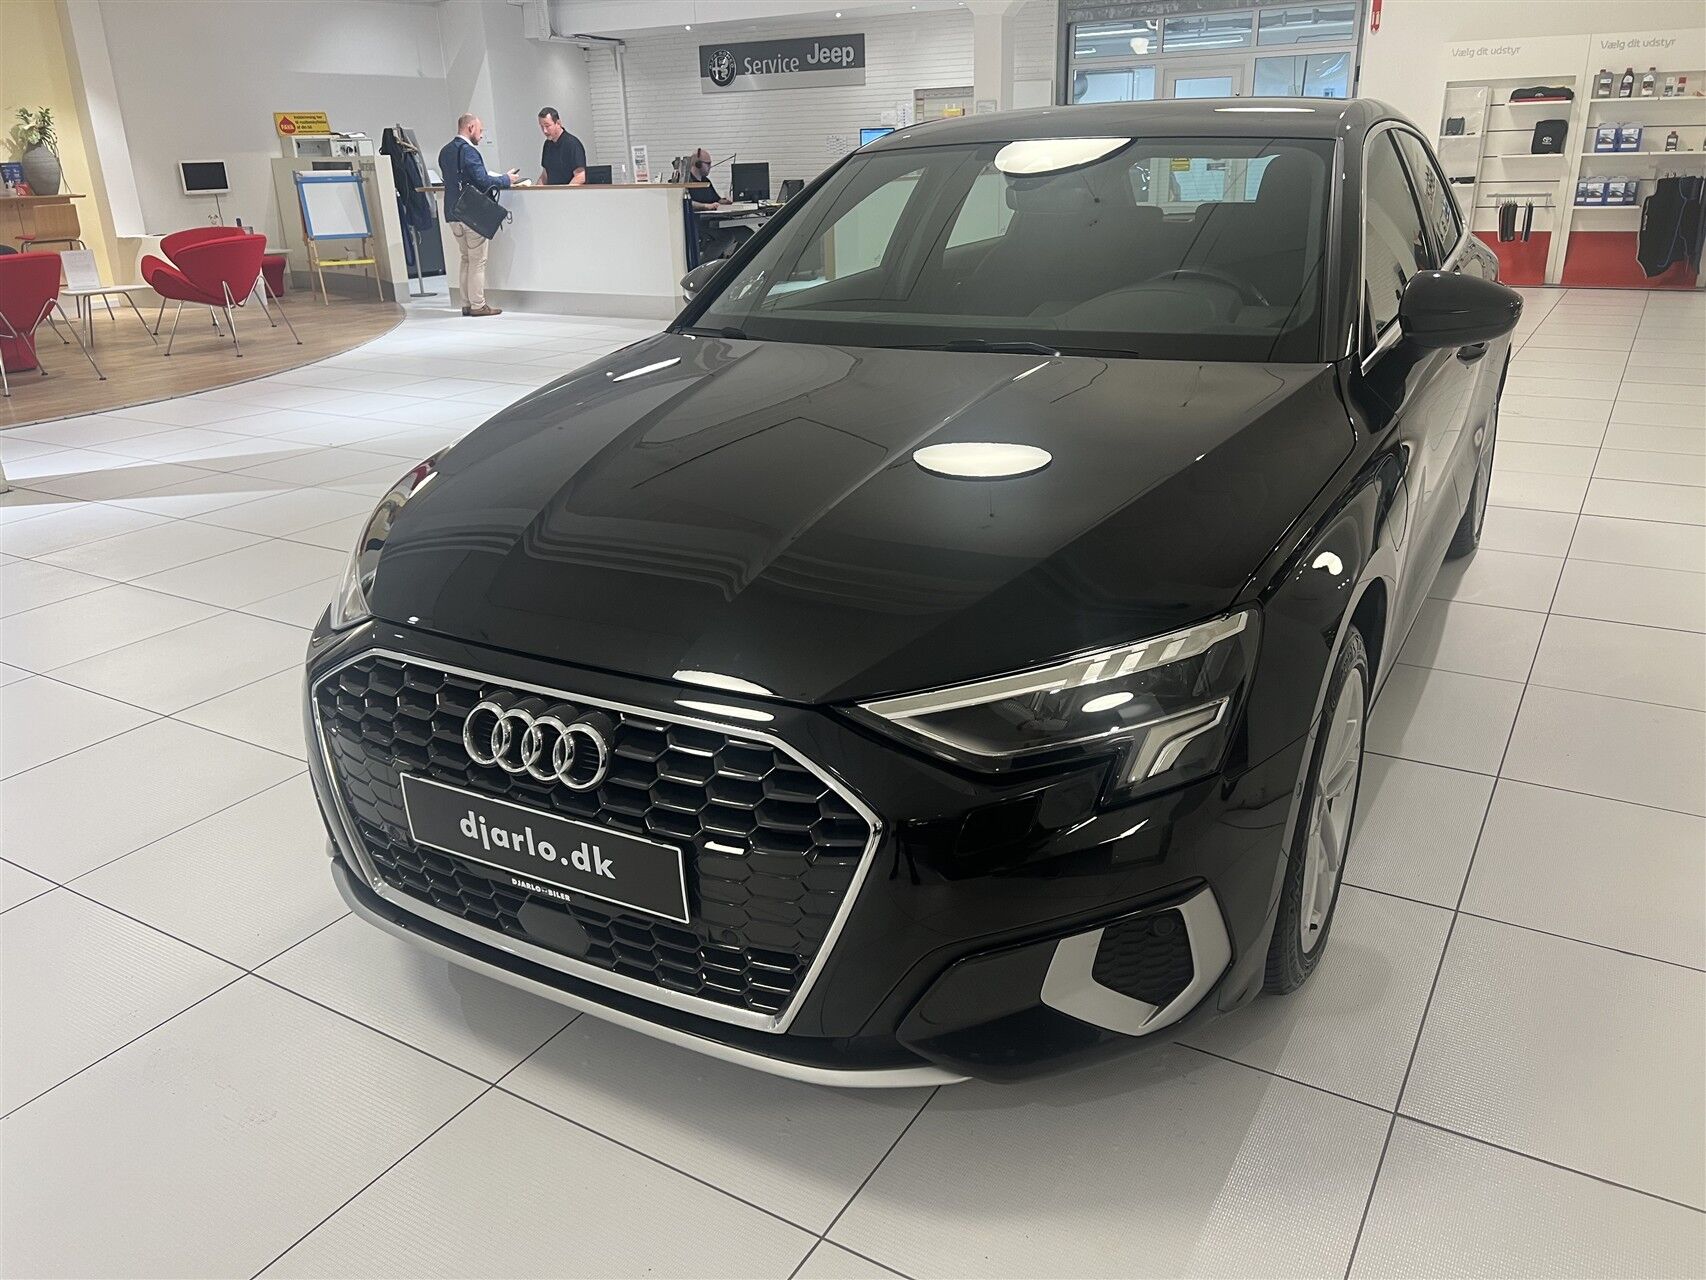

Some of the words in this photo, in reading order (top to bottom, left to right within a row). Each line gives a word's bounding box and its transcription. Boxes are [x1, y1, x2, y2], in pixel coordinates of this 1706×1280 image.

[1600, 40, 1626, 50] Vælg
[1627, 39, 1641, 48] dit
[1642, 38, 1677, 48] udstyr
[1451, 47, 1475, 58] Vælg
[1476, 47, 1489, 56] dit
[1490, 46, 1521, 56] udstyr
[744, 54, 800, 75] Service
[807, 43, 855, 66] Jeep
[459, 810, 616, 880] djarlo.dk
[547, 889, 571, 902] BILER
